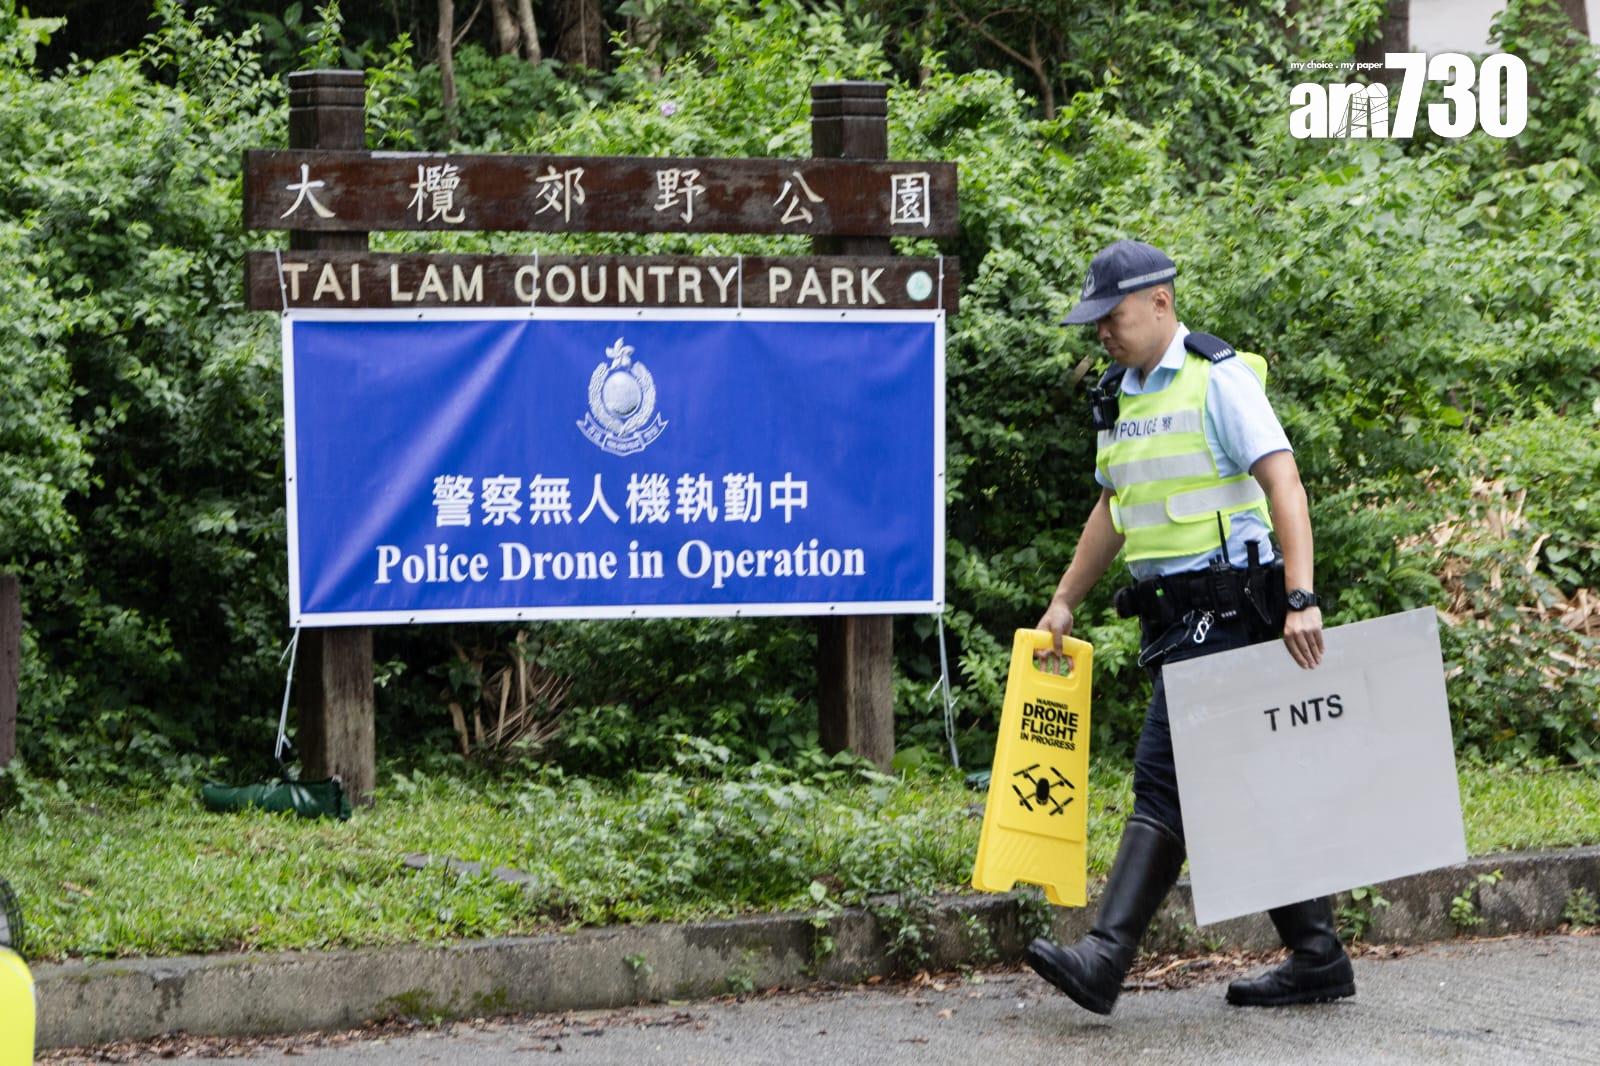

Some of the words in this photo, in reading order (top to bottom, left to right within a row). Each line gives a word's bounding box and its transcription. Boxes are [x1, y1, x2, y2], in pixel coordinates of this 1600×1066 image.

[280, 164, 932, 229] 大欖郊野公園
[282, 263, 361, 302] TAI
[390, 263, 484, 303] LAM
[514, 265, 739, 304] COUNTRY
[768, 267, 887, 305] PARK
[1119, 417, 1158, 439] POLICE
[432, 472, 809, 528] 警察無人機執勤中
[374, 543, 489, 584] Police
[499, 541, 618, 582] Drone
[627, 540, 664, 580] in
[677, 539, 866, 588] Operation
[1021, 717, 1077, 742] FLIGHT
[1022, 701, 1079, 728] DRONE
[1020, 732, 1030, 741] IN
[1031, 734, 1076, 751] PROGRESS
